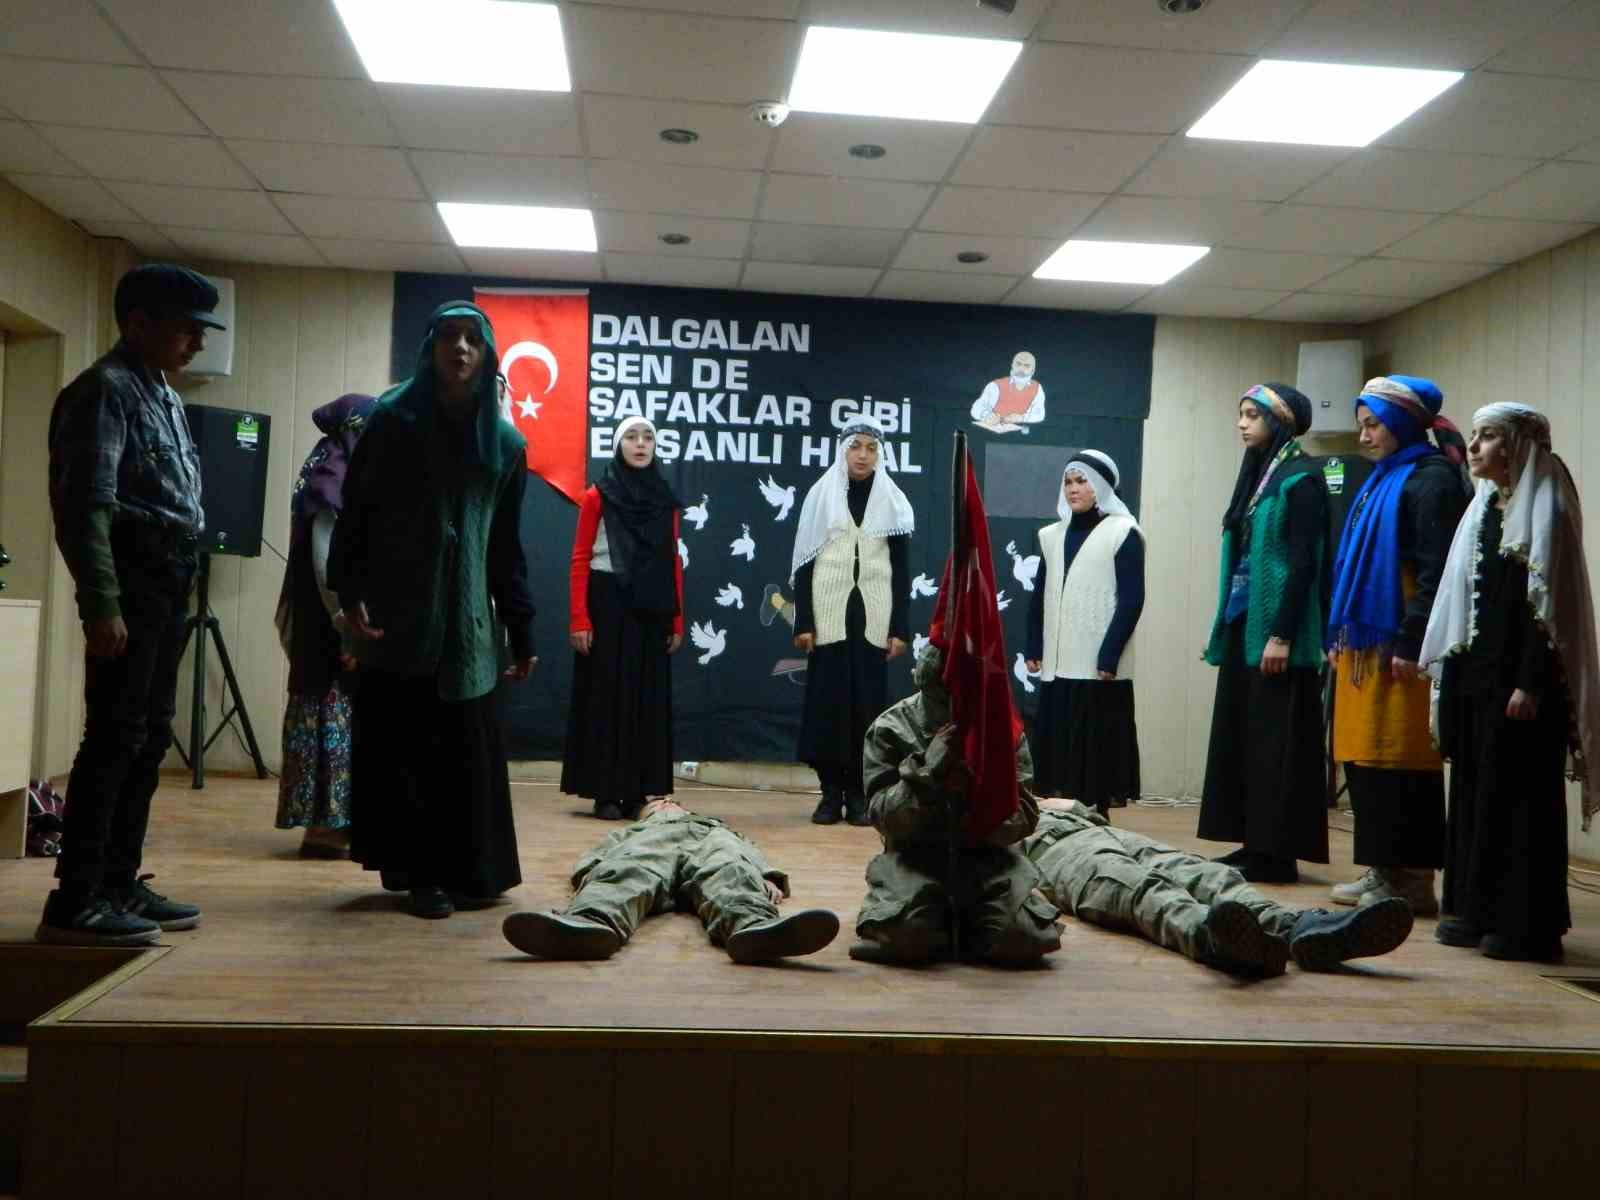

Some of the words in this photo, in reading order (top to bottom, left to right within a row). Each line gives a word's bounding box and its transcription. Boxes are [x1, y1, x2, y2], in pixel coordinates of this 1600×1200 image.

[592, 314, 810, 352] DALGALAN
[590, 352, 672, 384] SEN
[692, 358, 749, 390] DE
[589, 387, 811, 426] ŞAFAKLAR
[655, 428, 782, 464] ŞANLI
[801, 435, 922, 473] HAL
